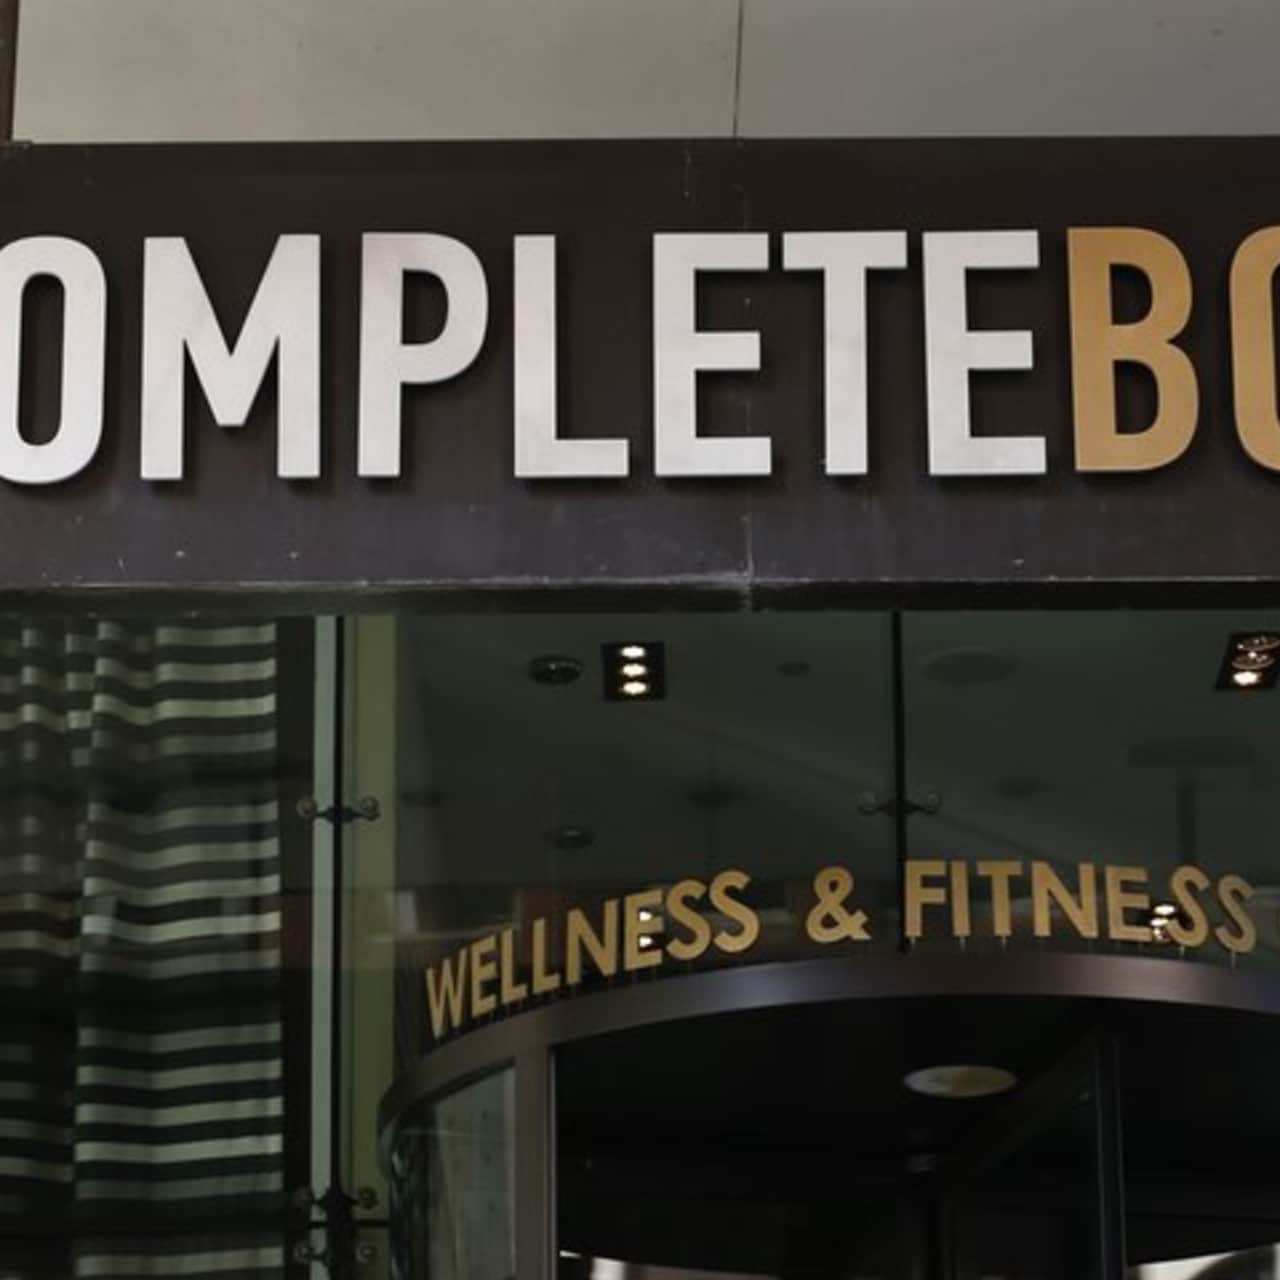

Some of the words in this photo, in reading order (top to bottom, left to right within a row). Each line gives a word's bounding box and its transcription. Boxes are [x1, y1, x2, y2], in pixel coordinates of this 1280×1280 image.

[425, 868, 759, 1041] WELLNESS
[805, 865, 872, 945] &
[904, 859, 1258, 955] FITNESS
